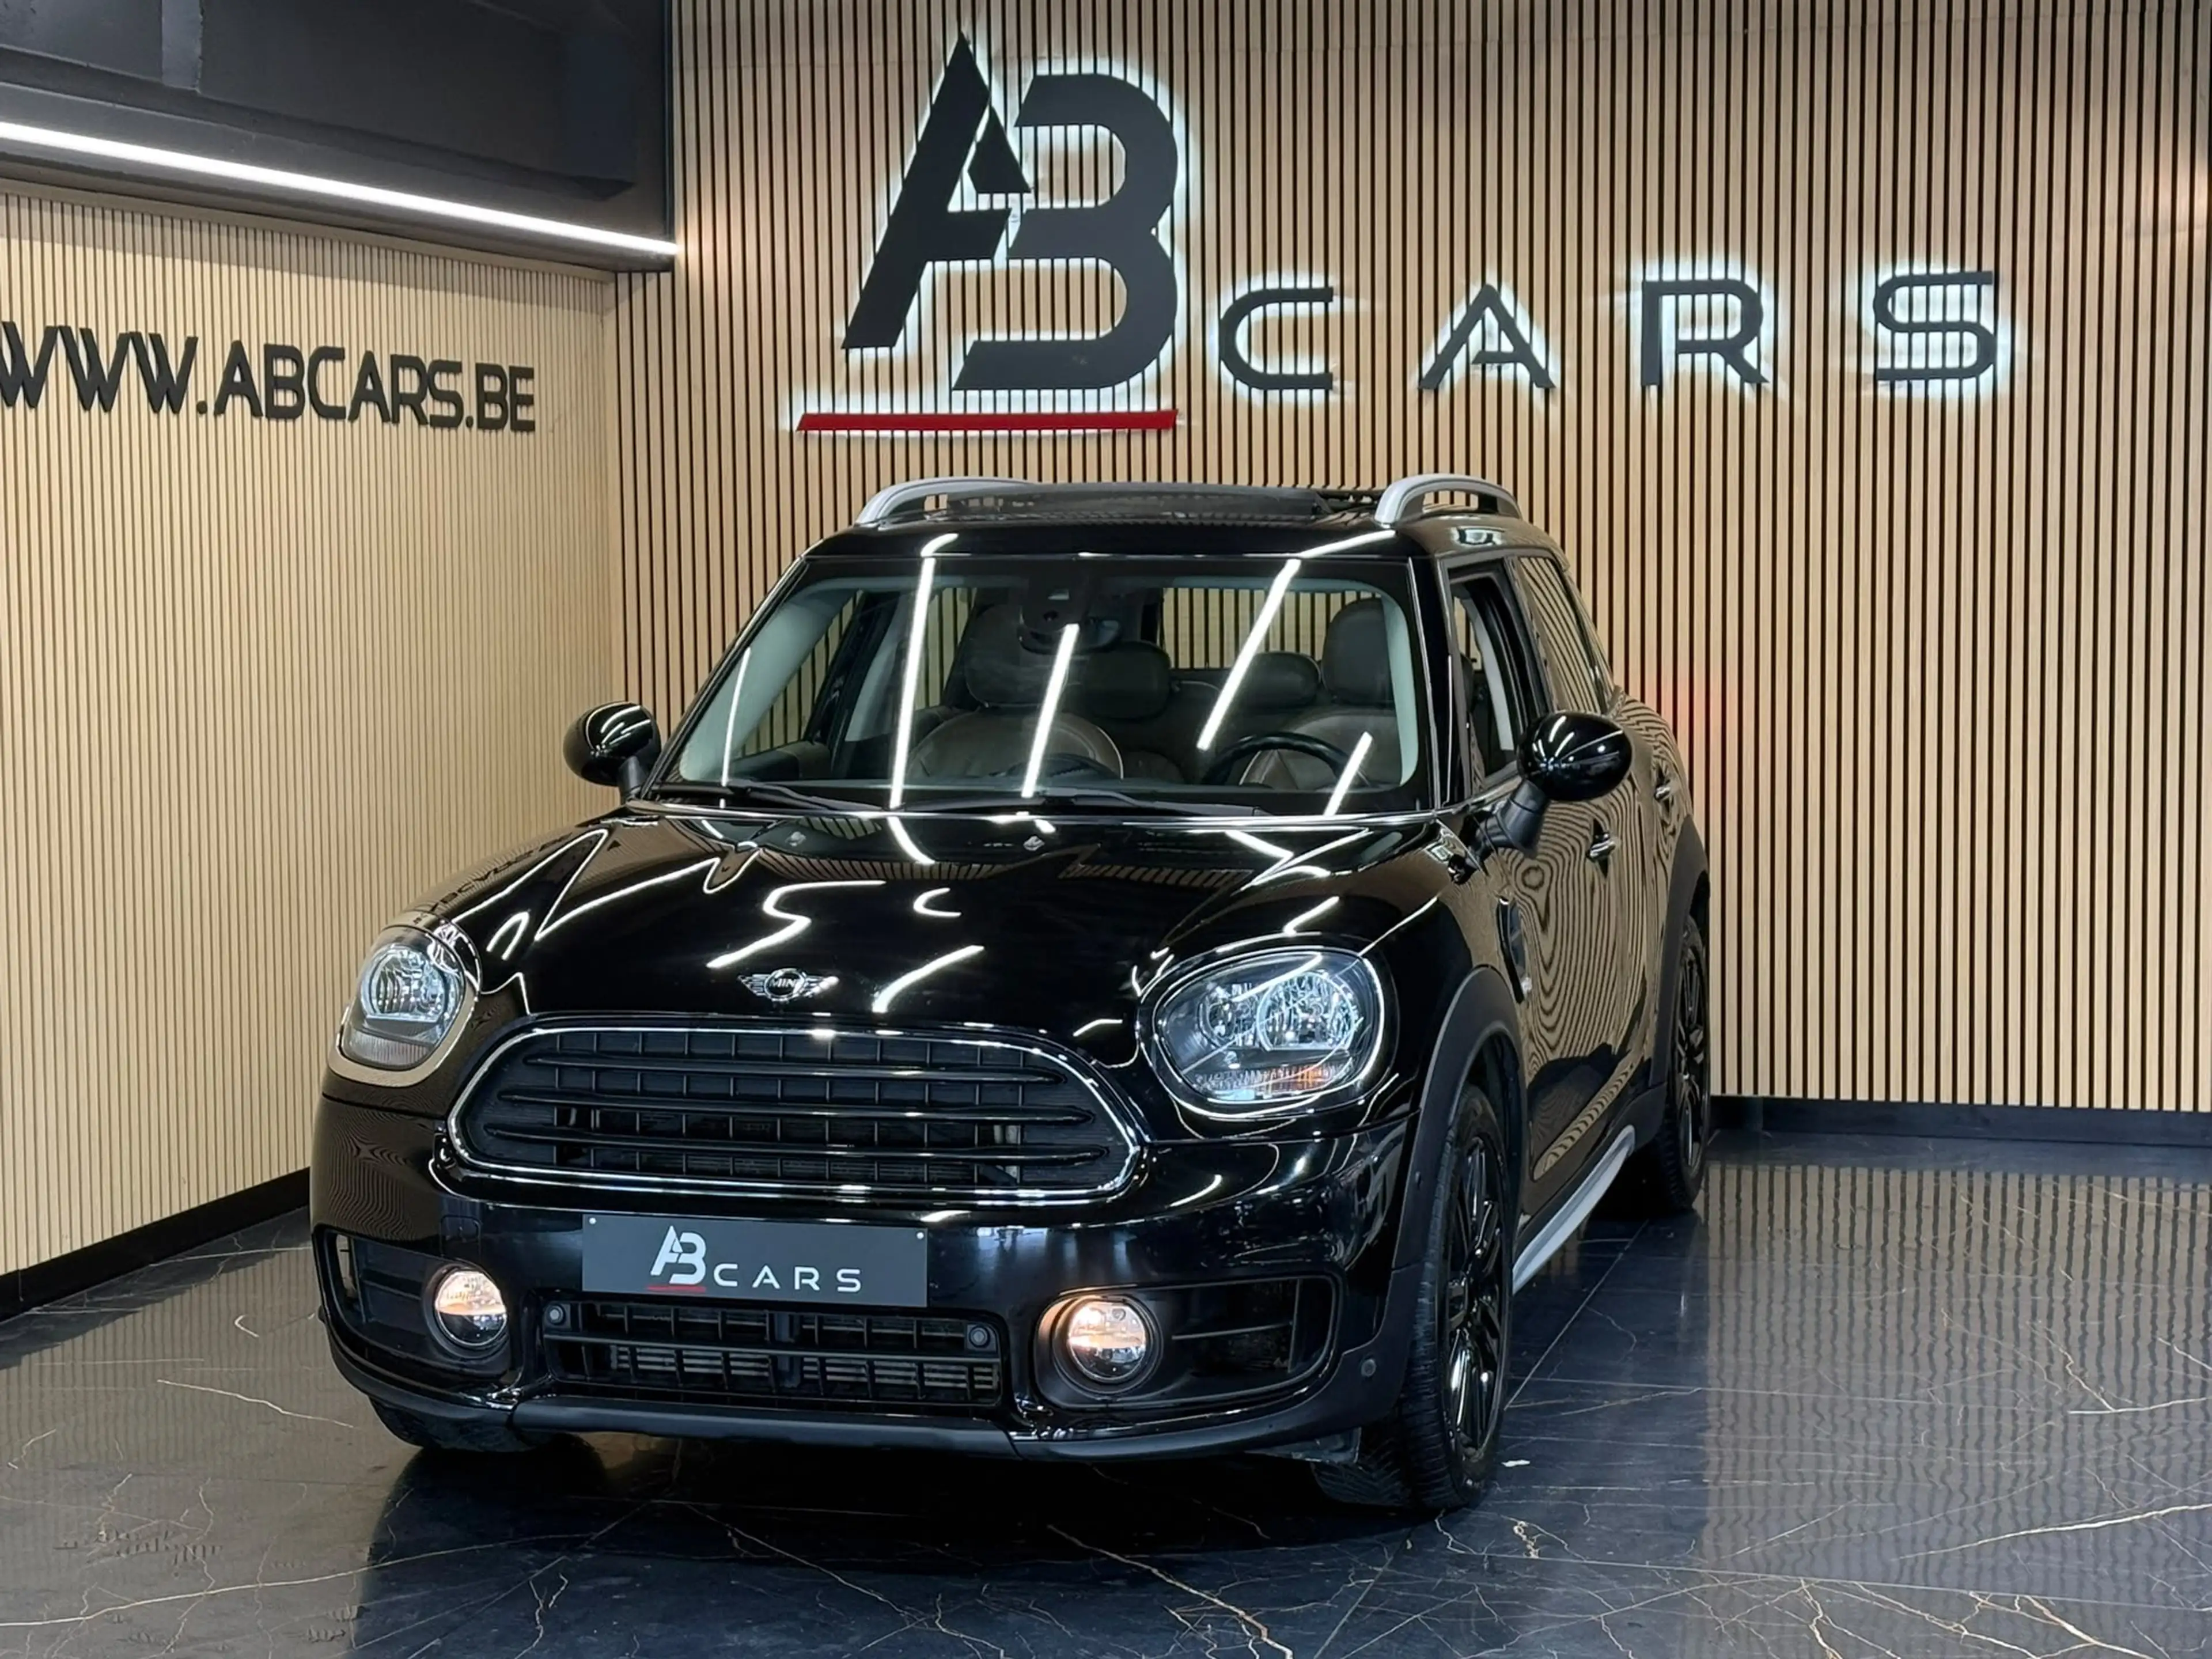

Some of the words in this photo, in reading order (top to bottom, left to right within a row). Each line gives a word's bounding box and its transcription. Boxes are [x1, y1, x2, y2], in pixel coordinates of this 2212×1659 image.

[840, 30, 1179, 391] AB
[1219, 270, 1998, 391] CARS
[0, 321, 536, 432] WWW.ABCARS.BE
[650, 1225, 707, 1285] AB
[713, 1263, 862, 1293] CARS
